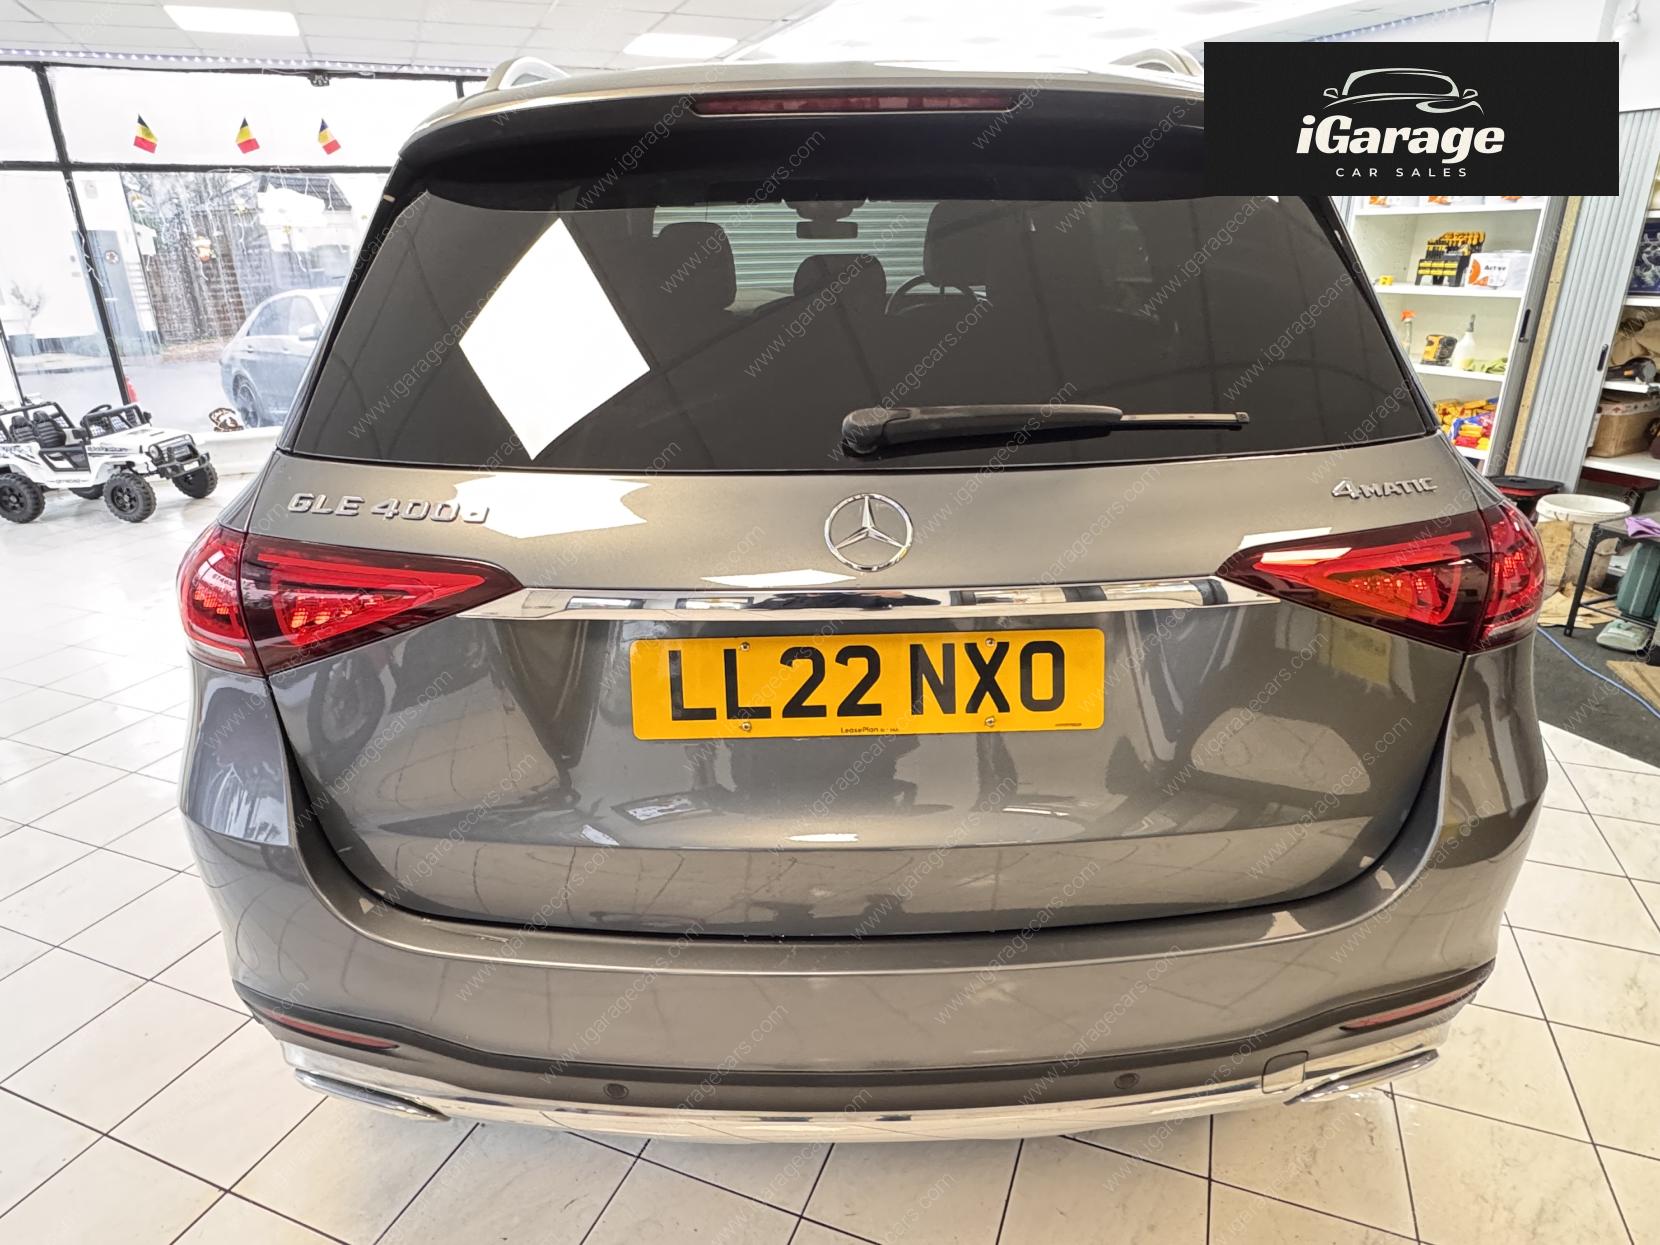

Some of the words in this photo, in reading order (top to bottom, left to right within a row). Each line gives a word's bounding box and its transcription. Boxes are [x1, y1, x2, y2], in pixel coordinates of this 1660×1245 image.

[1332, 477, 1438, 499] 4MATIC
[287, 493, 365, 517] GLE
[371, 498, 490, 524] 400d
[668, 645, 882, 721] LL22
[909, 640, 1065, 715] NXO
